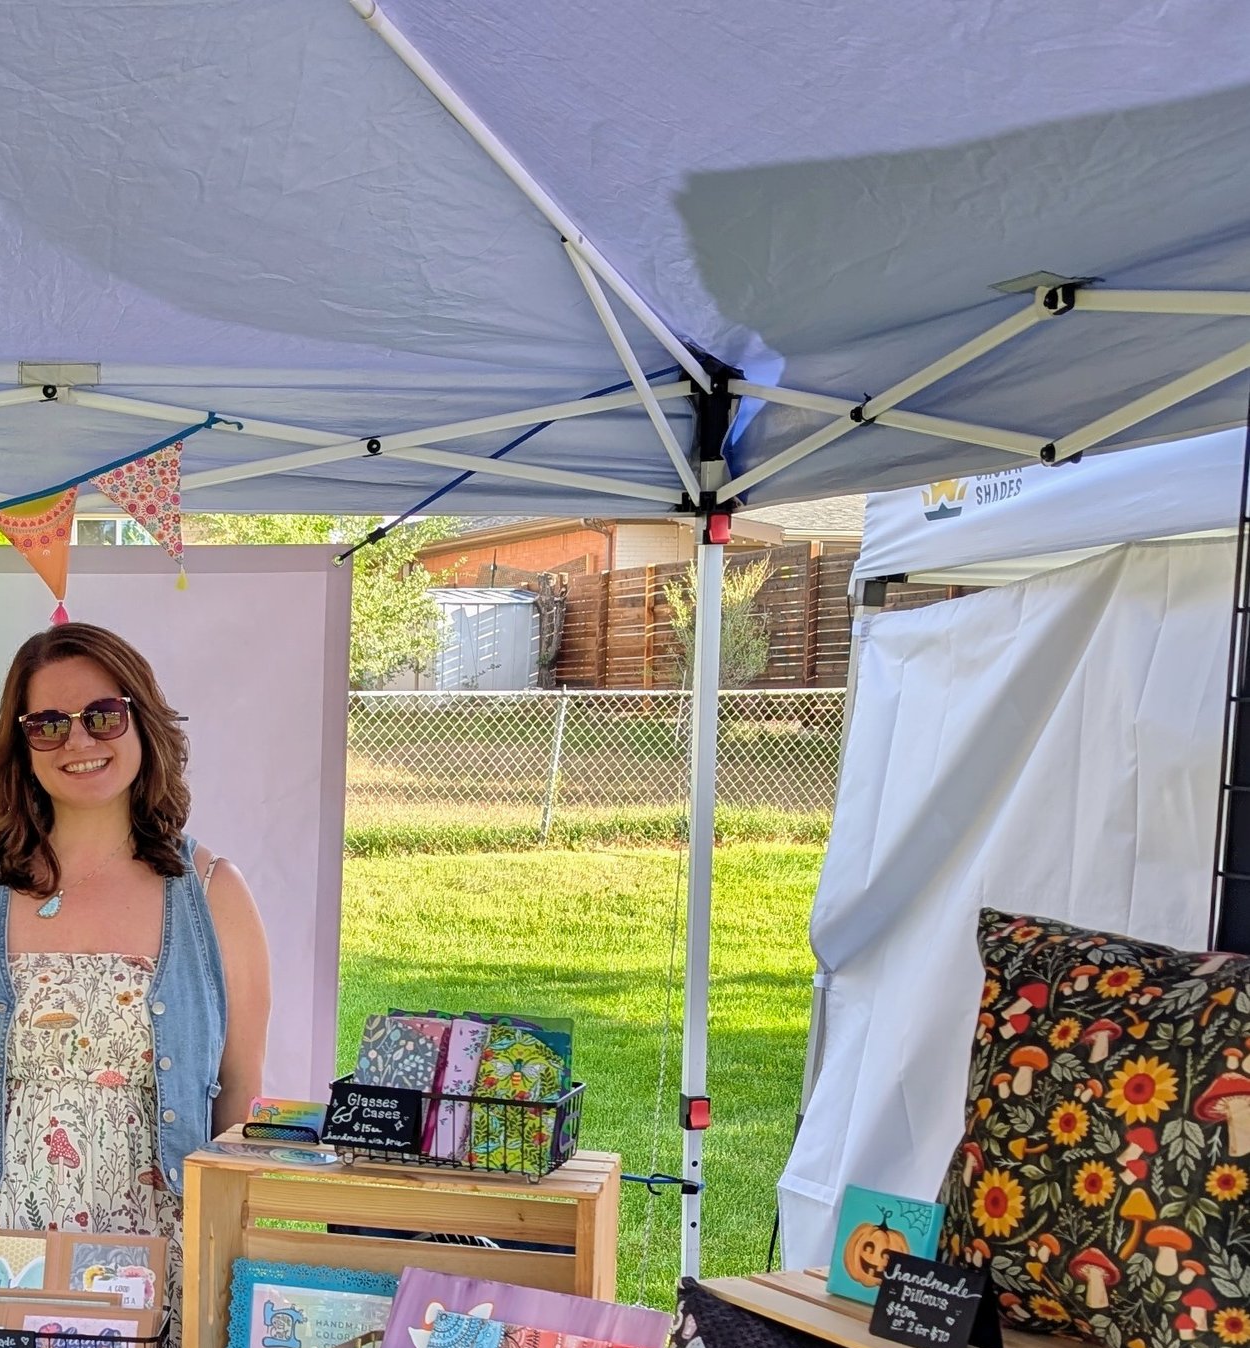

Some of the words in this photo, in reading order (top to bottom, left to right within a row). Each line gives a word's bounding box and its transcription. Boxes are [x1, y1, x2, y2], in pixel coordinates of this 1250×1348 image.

[976, 478, 1022, 505] SHADES
[347, 1092, 399, 1109] Glasses
[362, 1108, 401, 1119] Cases
[884, 1263, 982, 1299] handmade
[891, 1319, 905, 1331] or
[906, 1321, 914, 1333] 2
[914, 1324, 930, 1337] for
[930, 1326, 950, 1342] $70
